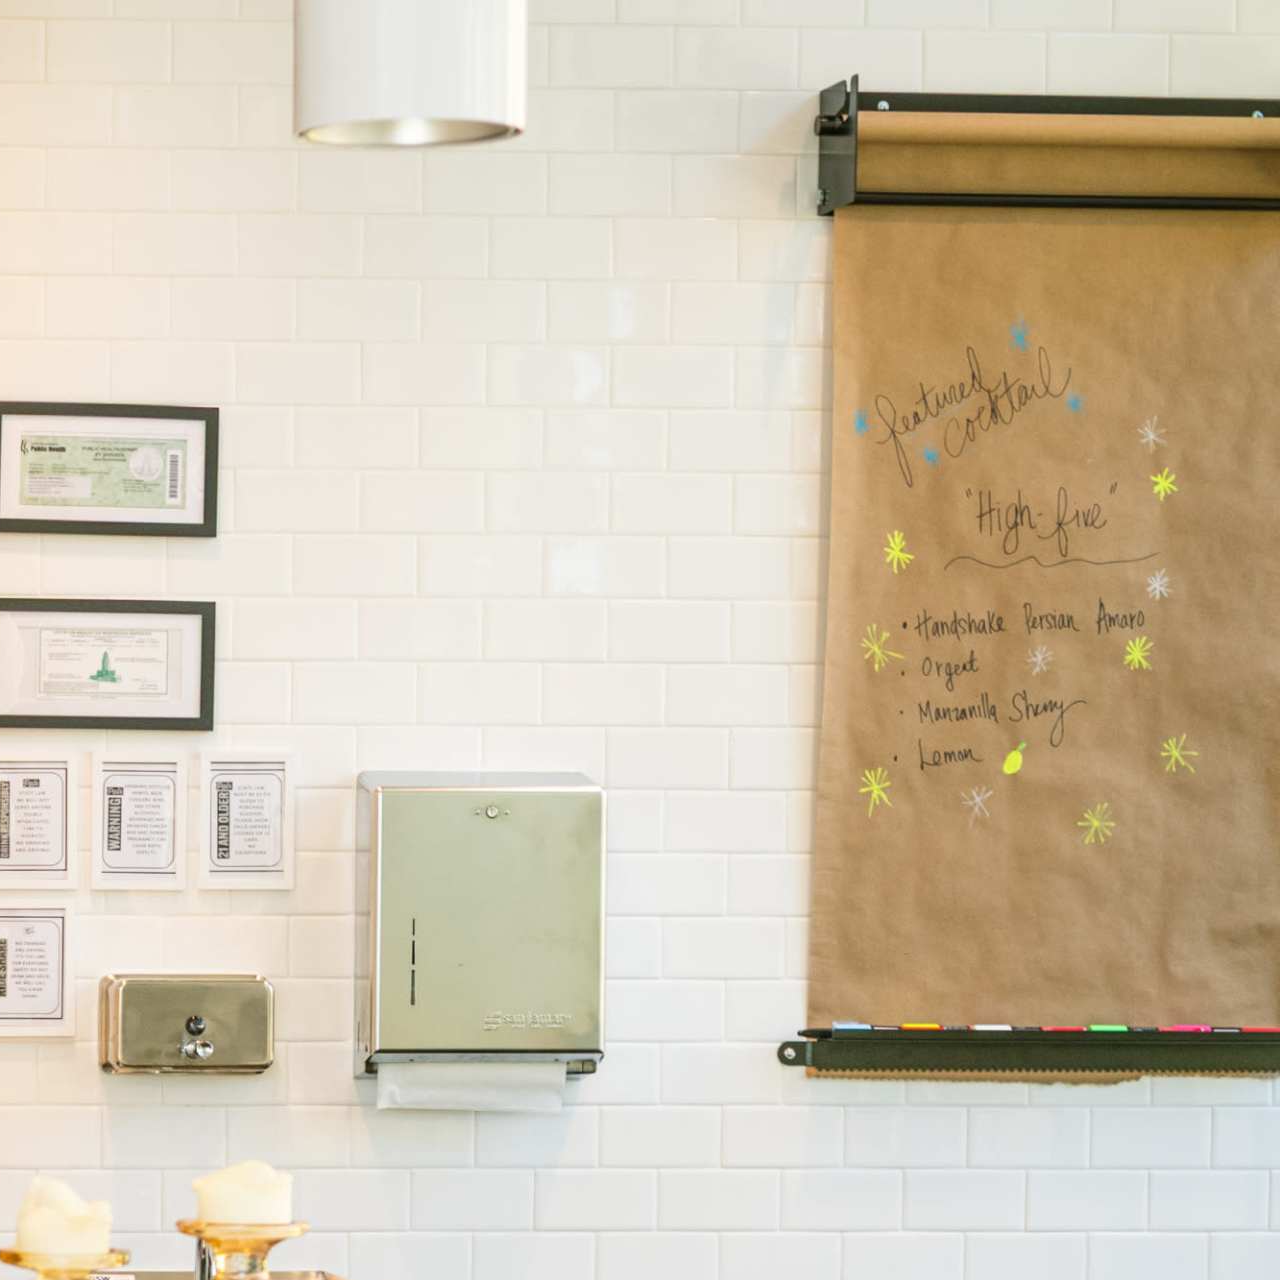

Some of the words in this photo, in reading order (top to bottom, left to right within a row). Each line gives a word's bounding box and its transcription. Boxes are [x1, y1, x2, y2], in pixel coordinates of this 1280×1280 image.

[877, 346, 1000, 488] featured
[944, 346, 1071, 458] cocktail
[914, 609, 1008, 641] Handshake
[1023, 601, 1081, 634] Persian
[1097, 598, 1146, 635] Amaro
[921, 650, 980, 691] Orgeat
[918, 693, 999, 724] Manzanilla
[1008, 692, 1088, 748] Sherry
[918, 738, 984, 770] Lemon
[109, 798, 121, 850] WARNING
[219, 791, 229, 823] OLDER
